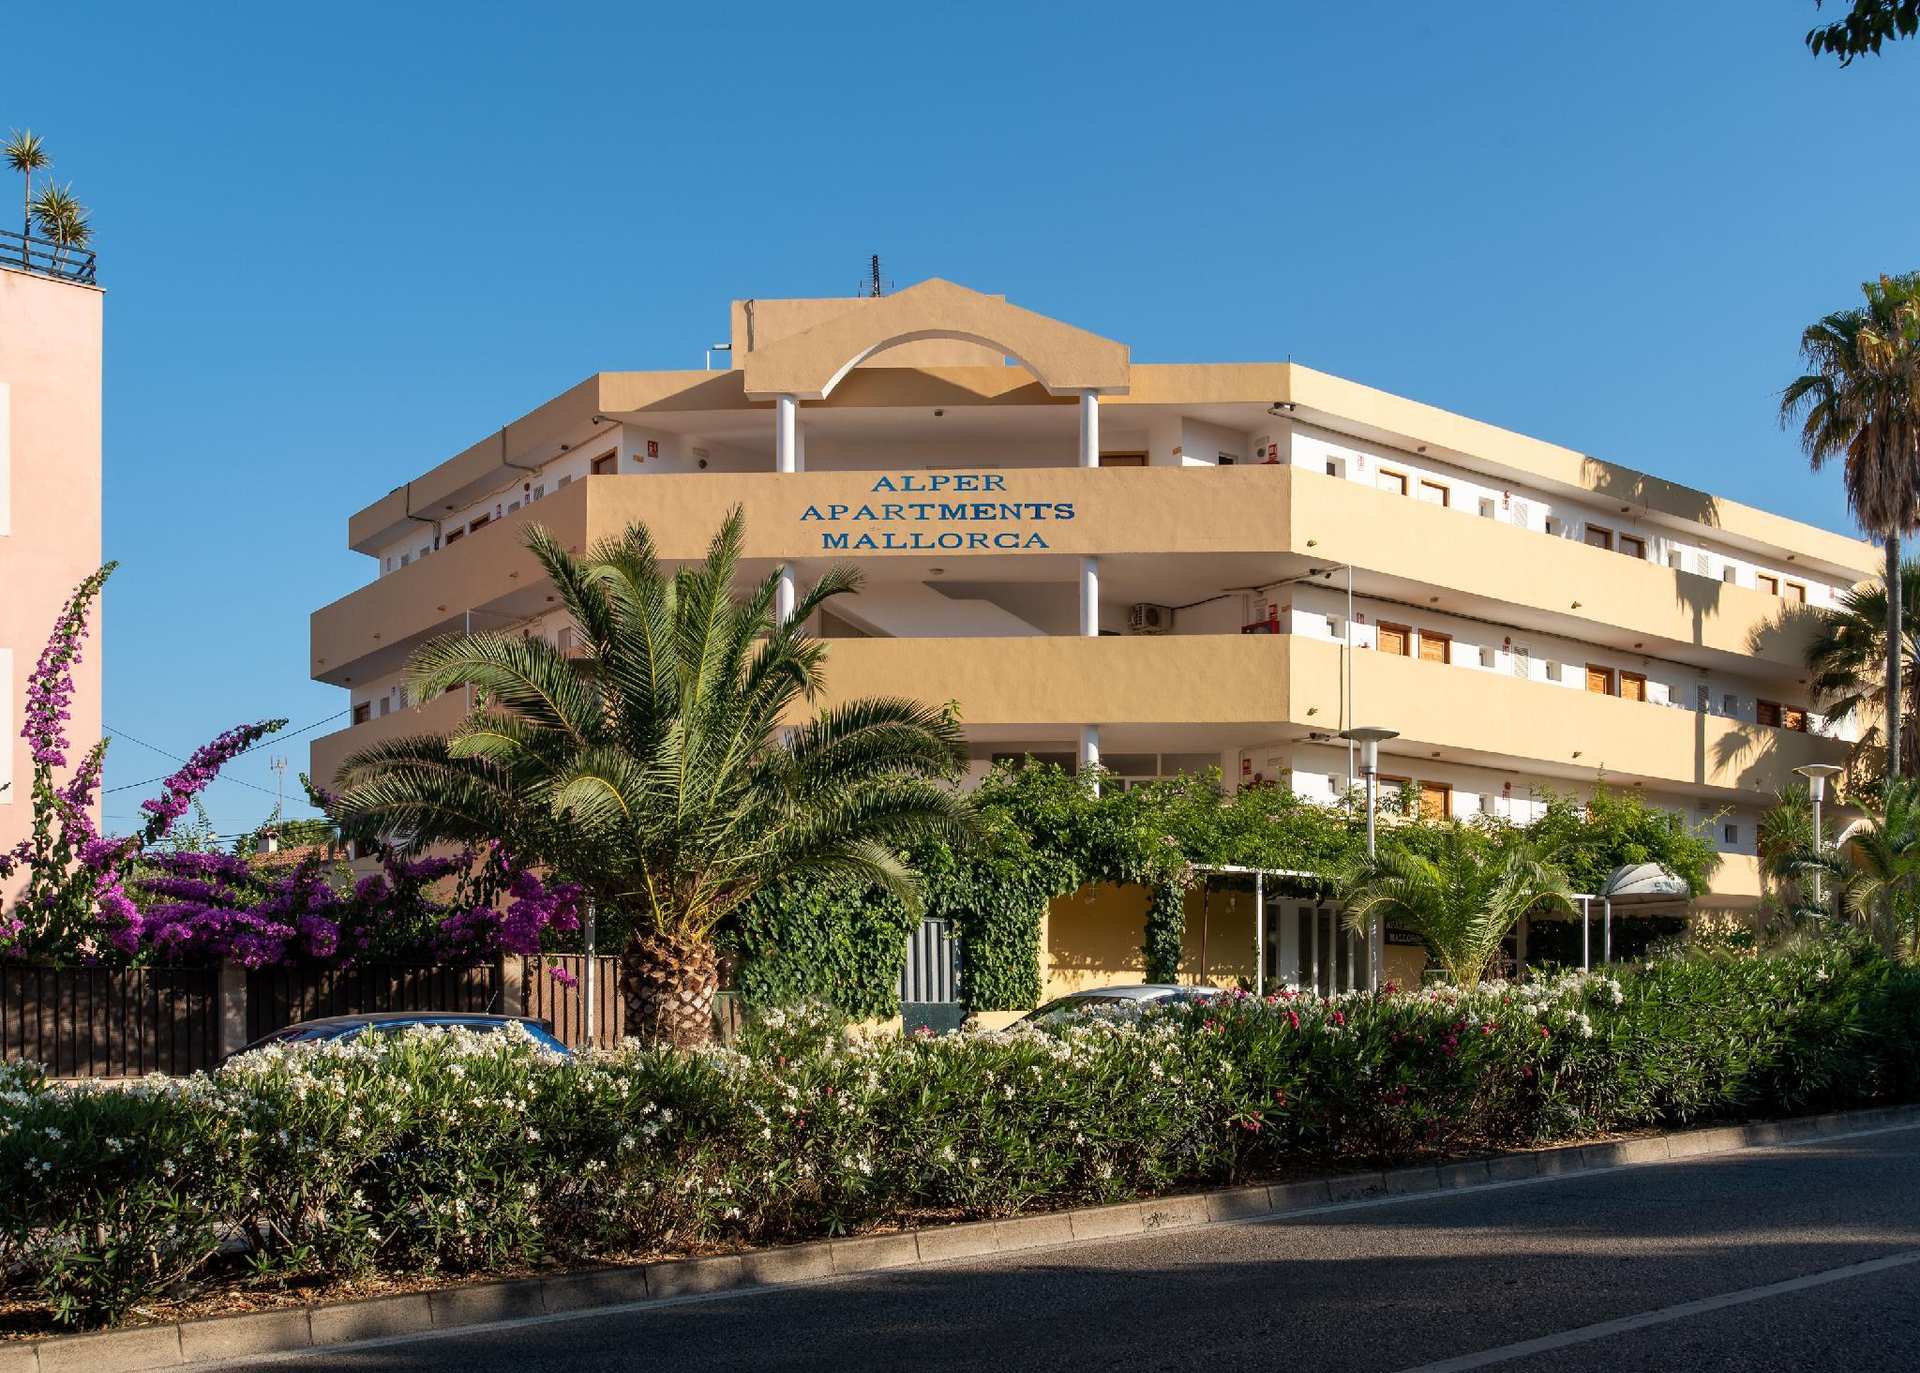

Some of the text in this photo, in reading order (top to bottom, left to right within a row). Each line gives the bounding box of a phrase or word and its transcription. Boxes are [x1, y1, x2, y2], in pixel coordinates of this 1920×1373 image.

[871, 474, 1008, 492] ALPER
[800, 503, 1075, 520] APARTMENTS
[821, 532, 1050, 549] MALLORCA
